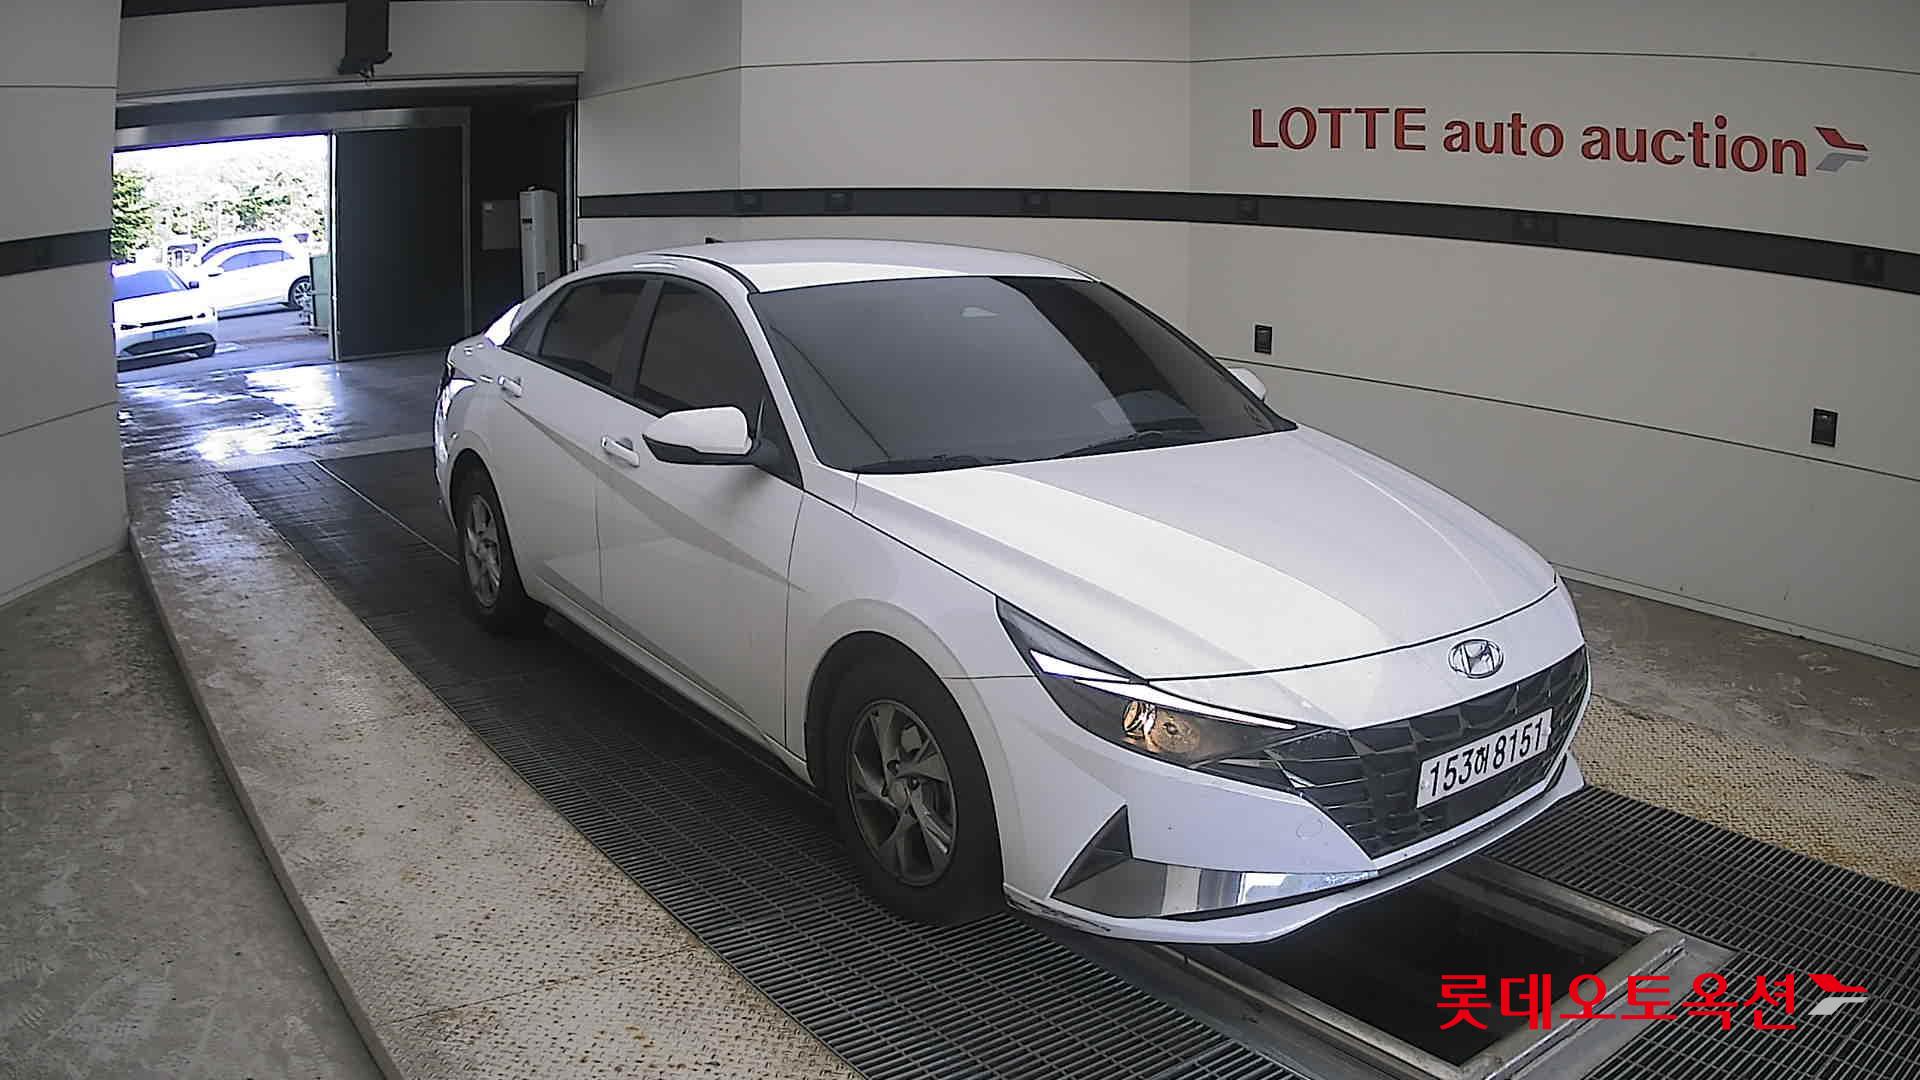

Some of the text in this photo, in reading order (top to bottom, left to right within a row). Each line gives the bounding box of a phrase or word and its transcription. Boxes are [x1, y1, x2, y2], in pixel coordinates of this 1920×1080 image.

[1252, 106, 1808, 177] LOTTE auto auction
